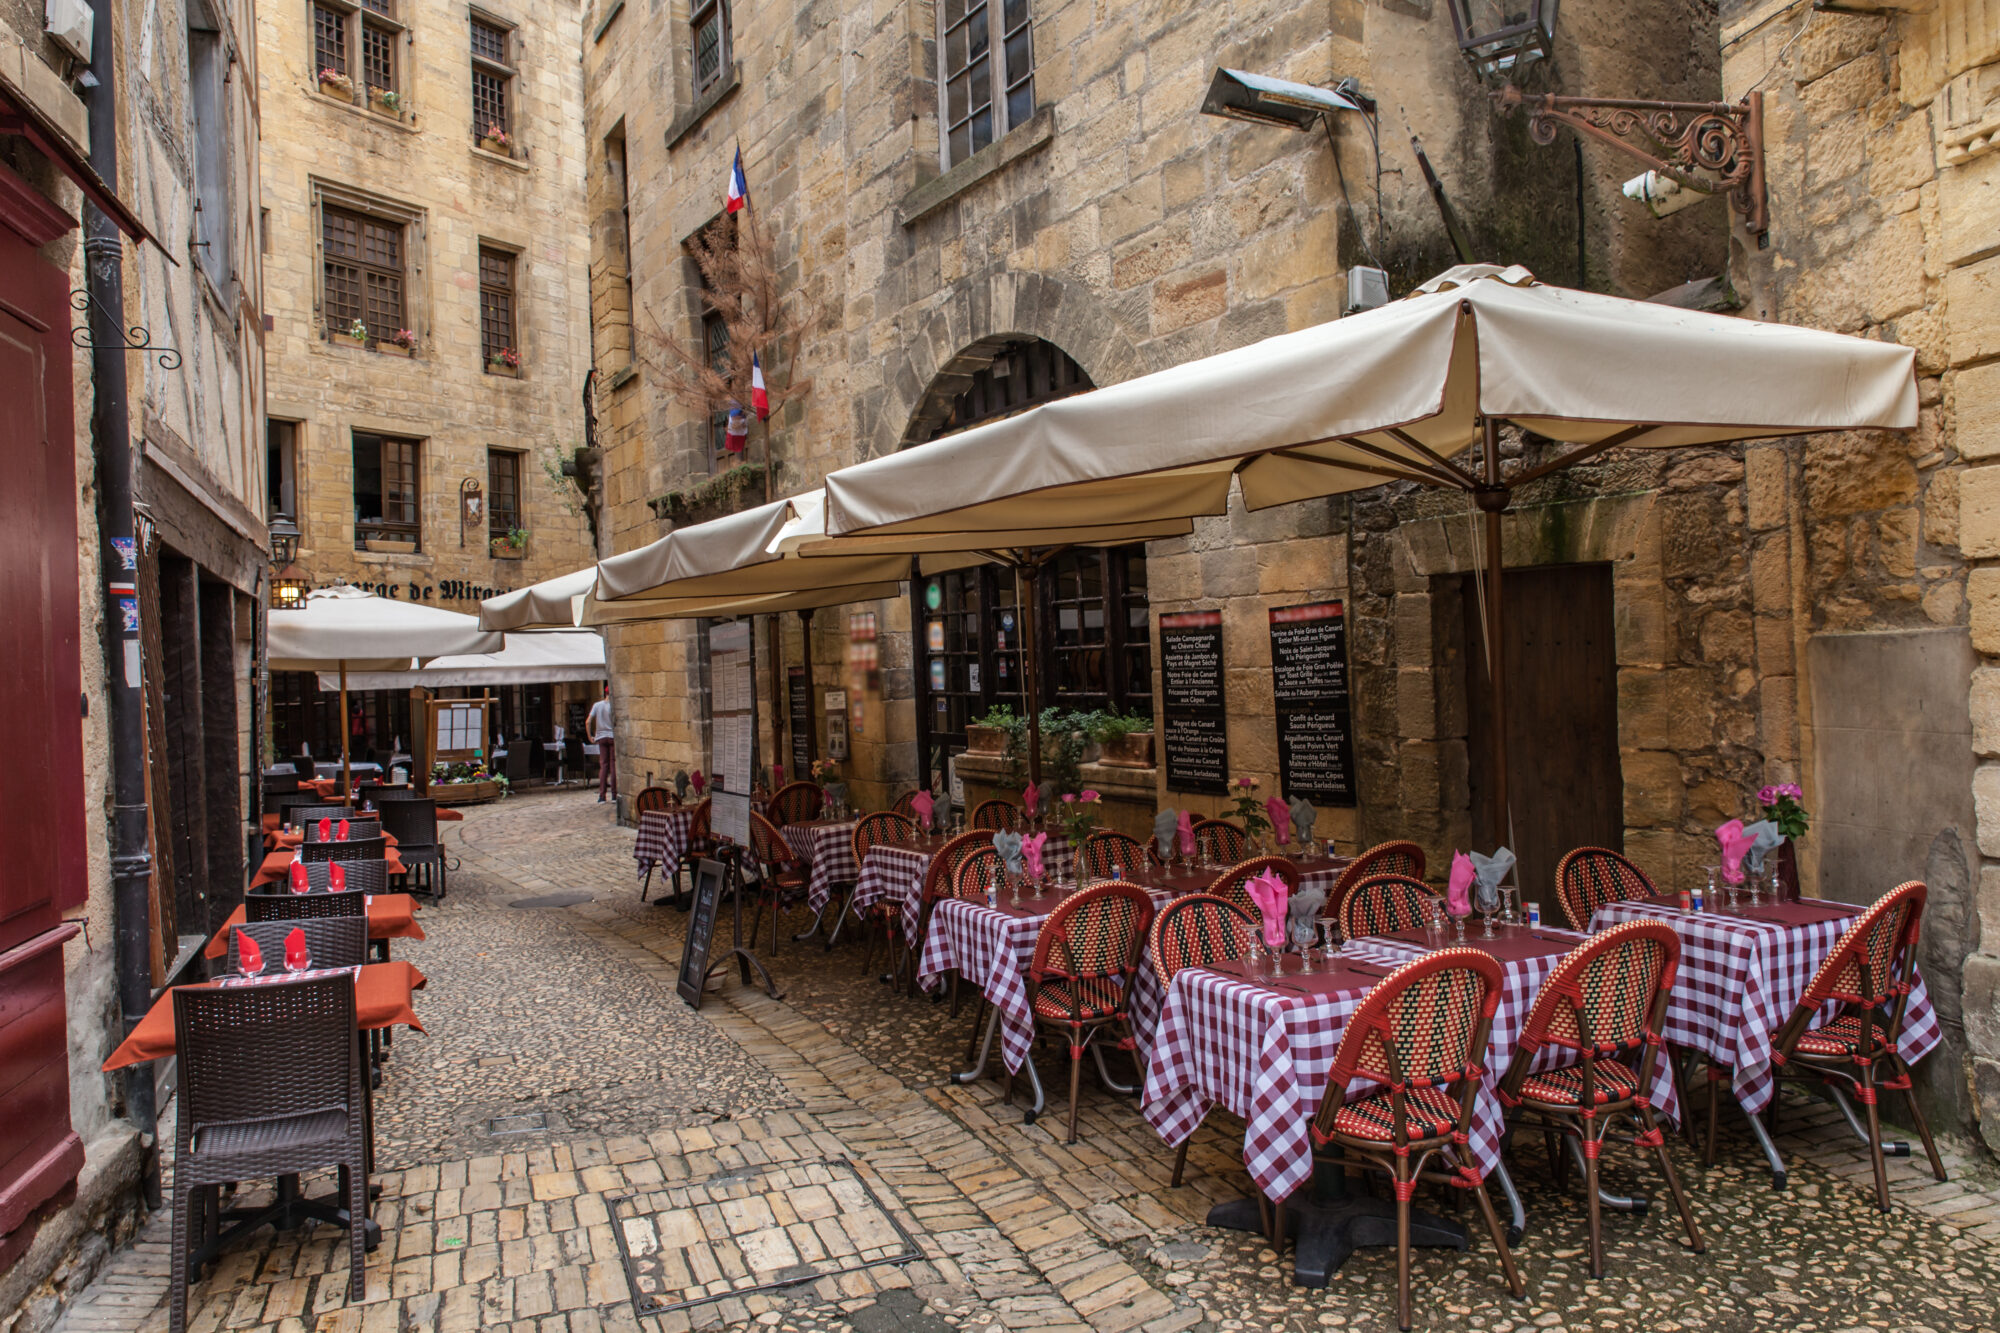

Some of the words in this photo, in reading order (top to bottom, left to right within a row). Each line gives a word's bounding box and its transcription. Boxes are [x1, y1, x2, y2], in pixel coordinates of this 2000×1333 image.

[409, 581, 433, 601] de
[1182, 634, 1215, 643] Campagnarde
[1297, 689, 1320, 697] l'Auberge
[1307, 722, 1335, 730] Périgueux
[1284, 735, 1314, 743] Aiguillettes
[1326, 772, 1344, 780] Cèpes
